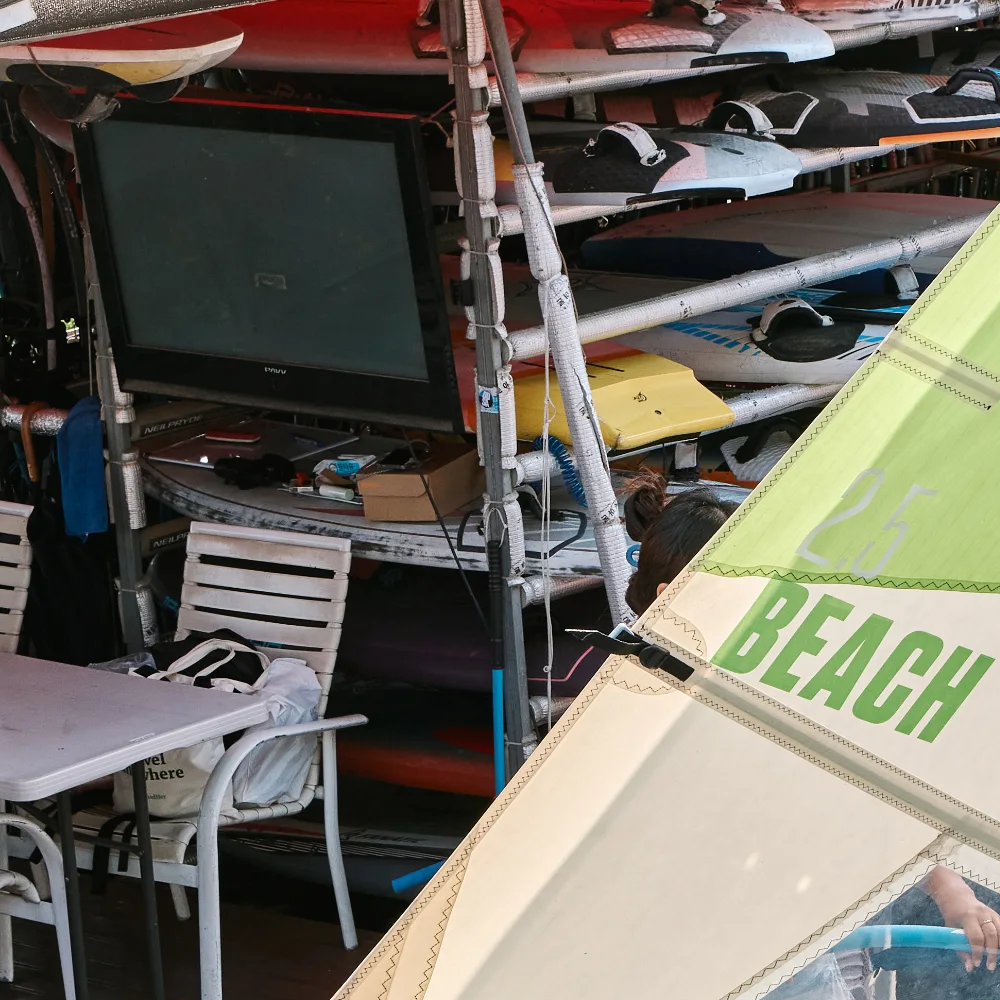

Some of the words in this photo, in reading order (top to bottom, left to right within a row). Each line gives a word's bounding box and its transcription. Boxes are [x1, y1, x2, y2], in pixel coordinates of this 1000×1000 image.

[153, 531, 189, 548] NEILPR
[795, 467, 939, 579] 2.5
[709, 571, 996, 744] BEACH
[144, 753, 166, 765] vel
